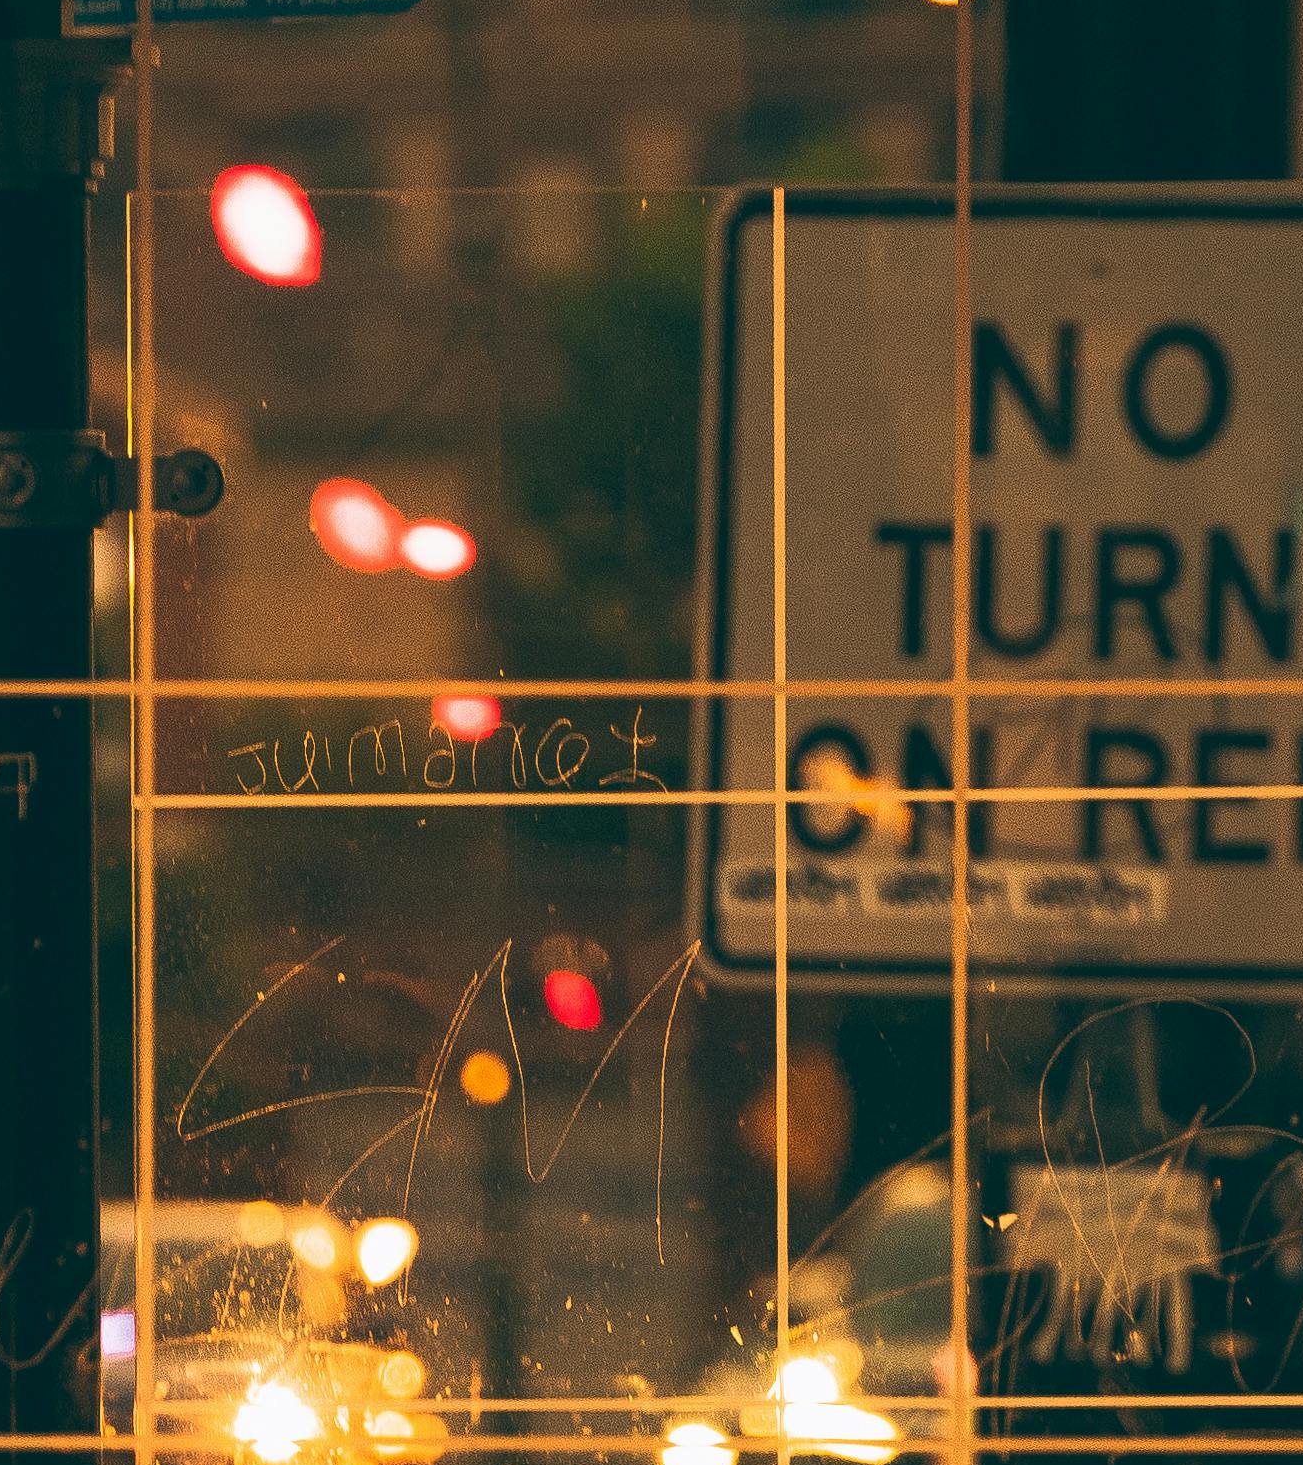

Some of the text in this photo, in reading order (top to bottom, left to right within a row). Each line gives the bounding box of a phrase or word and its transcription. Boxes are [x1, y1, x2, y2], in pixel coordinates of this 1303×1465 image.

[968, 318, 1234, 460] NO
[872, 519, 1296, 663] TURN
[784, 724, 993, 858] ON
